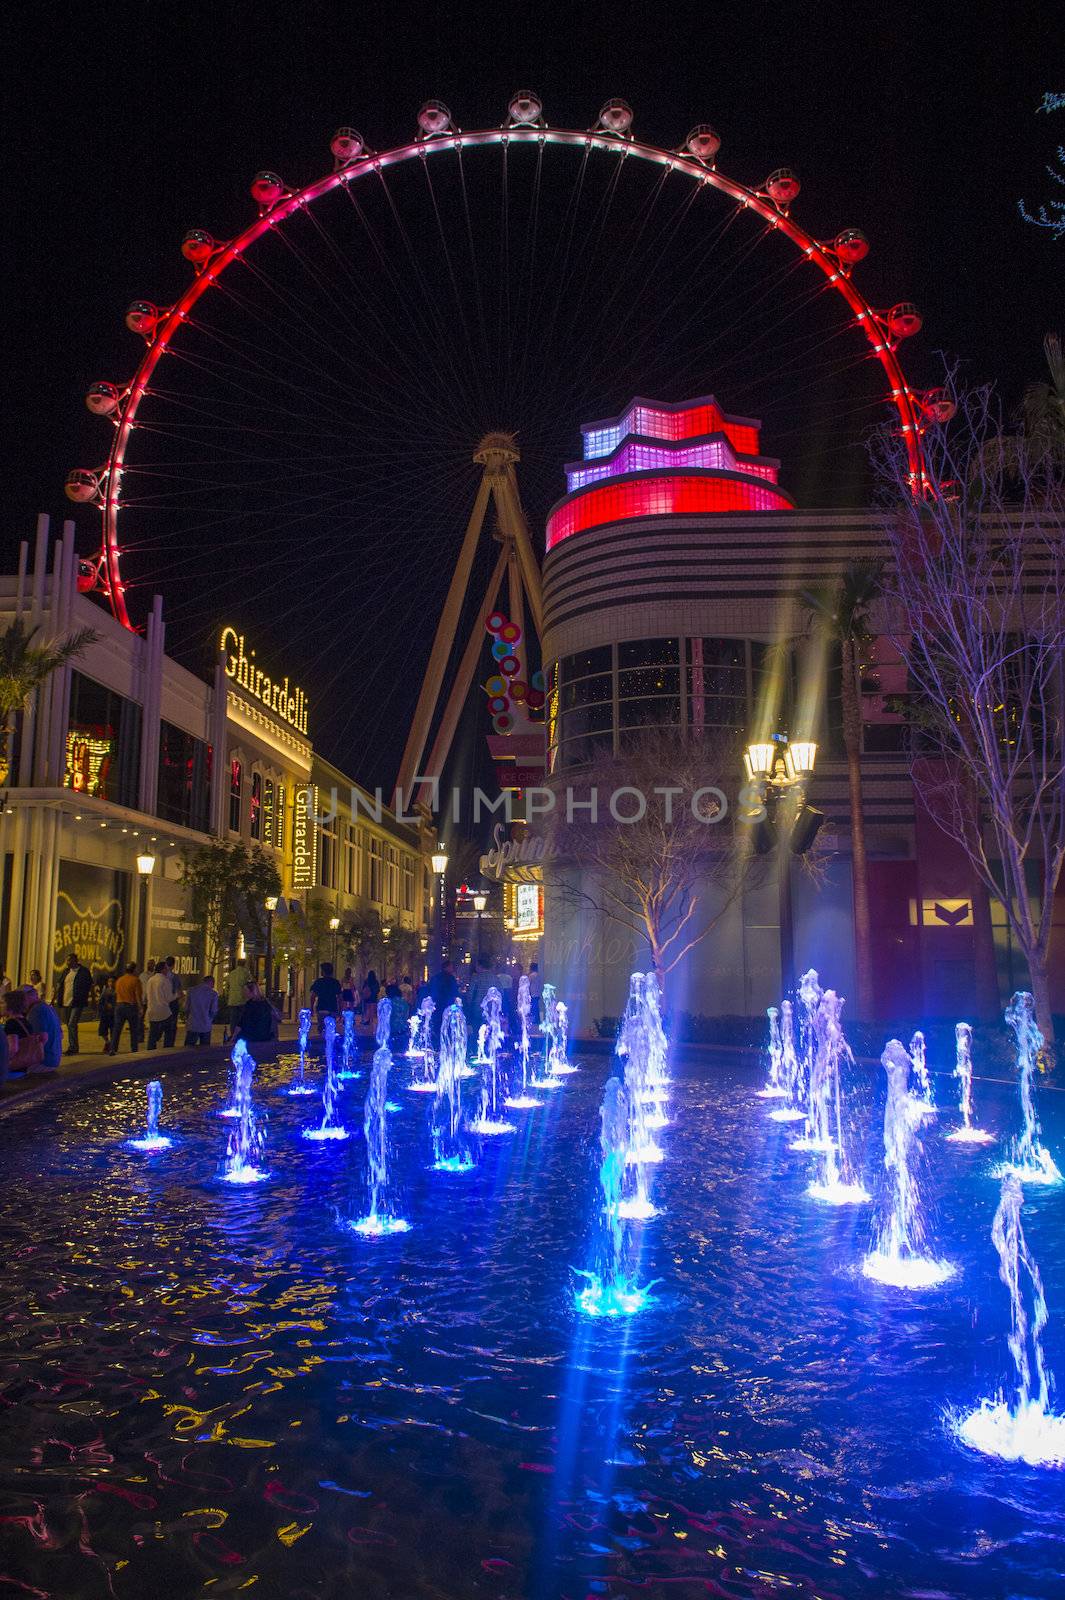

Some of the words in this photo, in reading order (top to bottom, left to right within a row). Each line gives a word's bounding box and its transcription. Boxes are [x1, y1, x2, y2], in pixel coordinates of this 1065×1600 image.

[220, 626, 309, 735] Ghirardelli
[294, 789, 311, 883] Ghirardelli
[55, 920, 119, 954] BROOKLYN
[75, 943, 102, 960] BOWL
